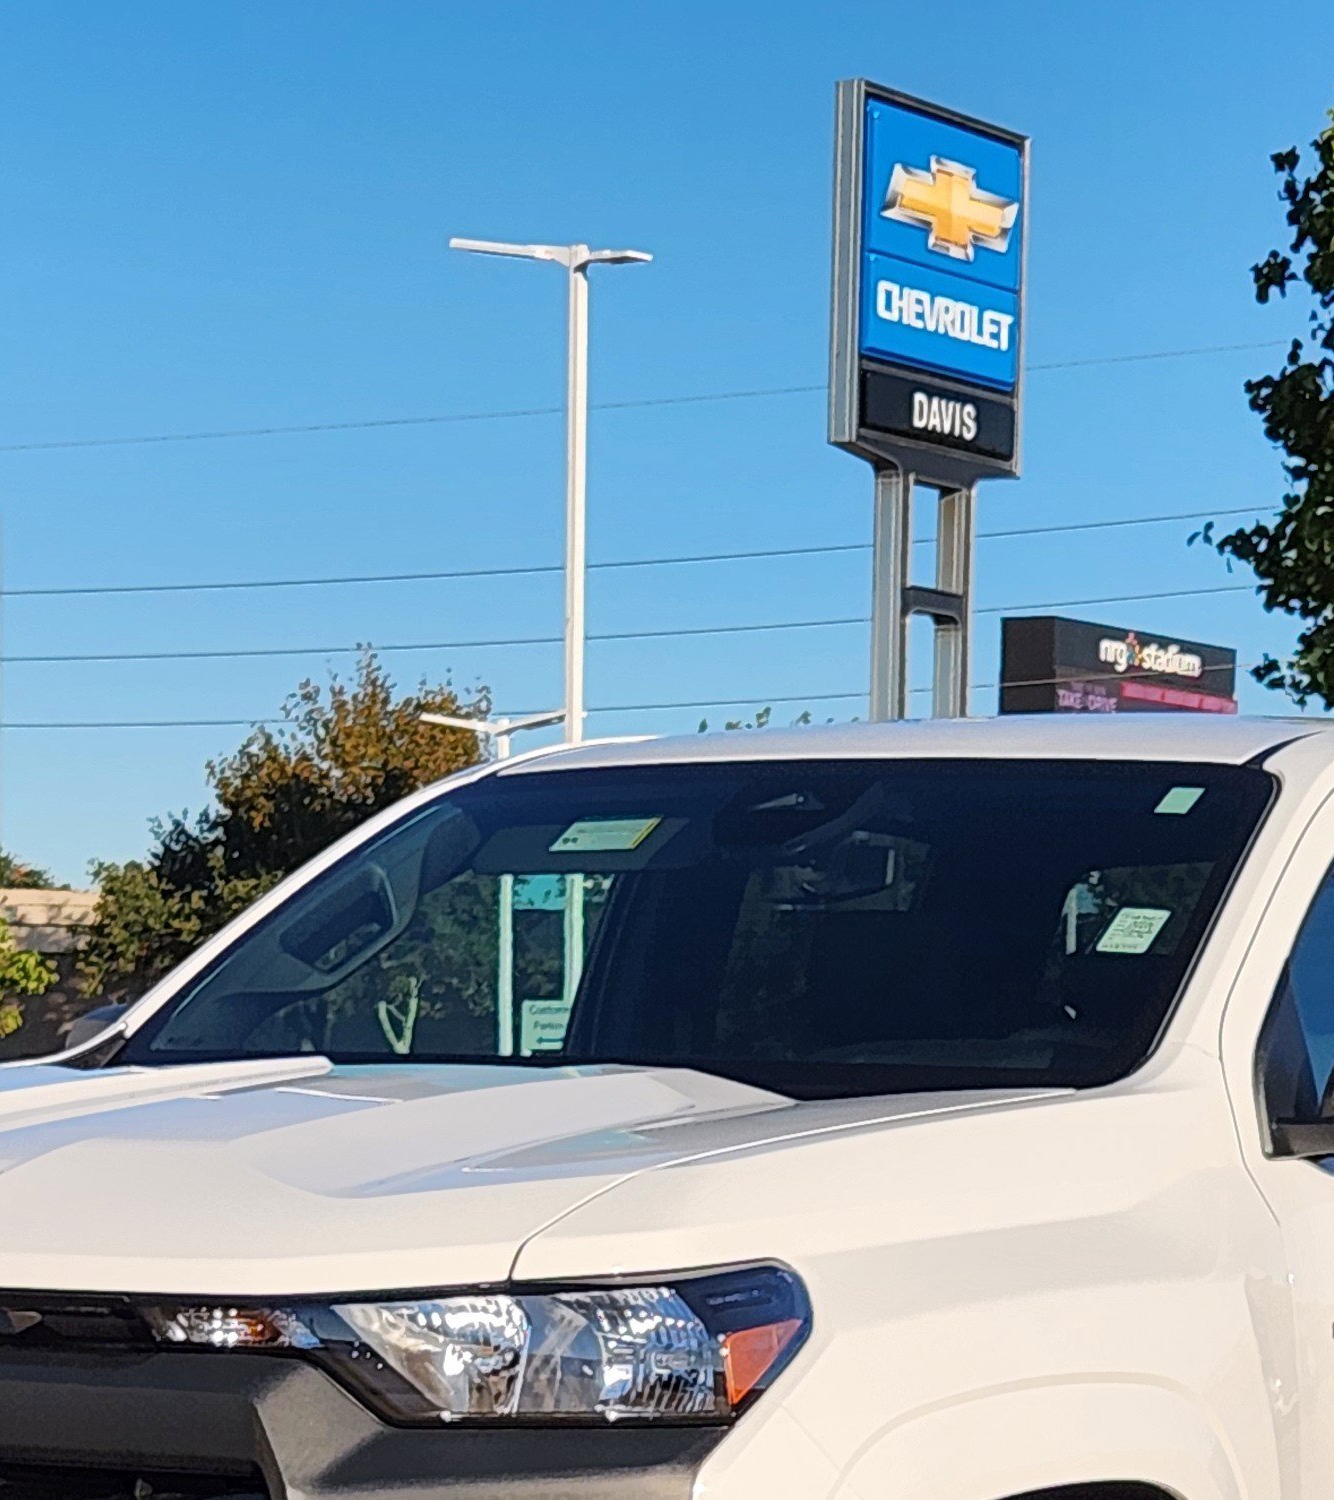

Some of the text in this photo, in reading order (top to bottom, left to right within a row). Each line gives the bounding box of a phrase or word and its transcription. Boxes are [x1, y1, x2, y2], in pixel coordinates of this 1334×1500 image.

[875, 278, 1014, 352] CHEVROLET
[912, 392, 978, 442] DAVIS
[1141, 643, 1203, 678] stadium
